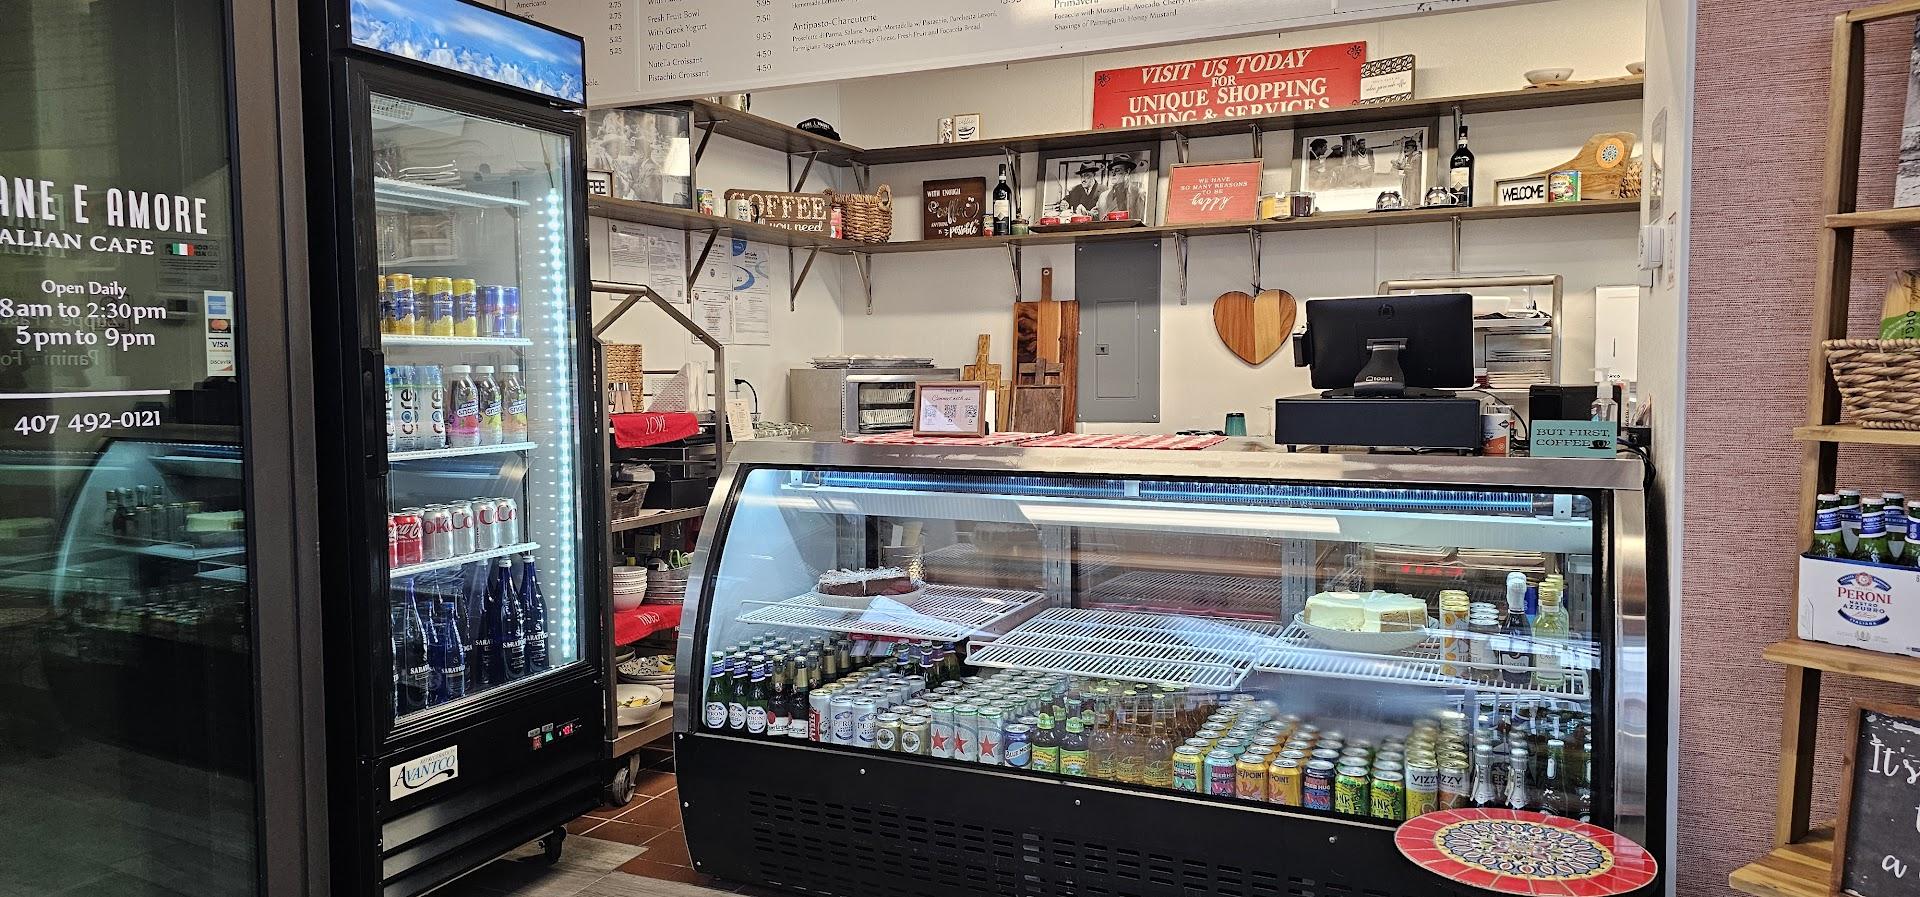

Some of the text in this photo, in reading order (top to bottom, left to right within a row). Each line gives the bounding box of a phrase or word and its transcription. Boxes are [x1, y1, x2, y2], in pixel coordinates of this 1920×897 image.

[647, 13, 664, 23] Fresh
[666, 13, 682, 21] Fruit
[683, 9, 700, 18] Bowl
[1054, 22, 1081, 31] Shavings
[1128, 14, 1148, 23] Honey
[1150, 9, 1177, 19] Mustard
[1081, 8, 1095, 17] with
[648, 27, 664, 37] With
[666, 24, 684, 35] Greek
[685, 23, 707, 33] Yogurt
[792, 15, 877, 31] Antipasto-Charcuterie
[648, 41, 664, 52] With
[665, 39, 691, 50] Granola
[648, 49, 772, 69] Nutella Croissant 4.50
[1141, 49, 1313, 85] VISIT US TODAY
[648, 63, 772, 82] Pistachio Croissant 4.50
[1211, 75, 1237, 88] FOR
[1128, 77, 1328, 115] UNIQUE SHOPPING
[1121, 108, 1197, 129] DINING
[1203, 107, 1217, 121] &
[1214, 181, 1248, 189] REASONS
[1502, 184, 1544, 202] WELCOME
[74, 183, 89, 225] E
[107, 187, 208, 235] AMORE
[1190, 192, 1233, 212] happy
[794, 221, 823, 232] need
[90, 235, 155, 256] CAFE
[41, 279, 127, 300] Open Daily
[0, 298, 167, 324] 8am to 2:30pm
[16, 325, 156, 351] 5pm to 9pm
[400, 388, 413, 435] core
[14, 410, 161, 436] 407 492-0121
[645, 414, 668, 435] LOVE
[1536, 428, 1610, 438] BUT FIRST,
[1536, 439, 1590, 447] COFFEE
[1838, 587, 1892, 604] PERONI
[1843, 603, 1885, 613] AZZURRO
[393, 755, 455, 789] AVANTCO
[1881, 854, 1908, 879] a
